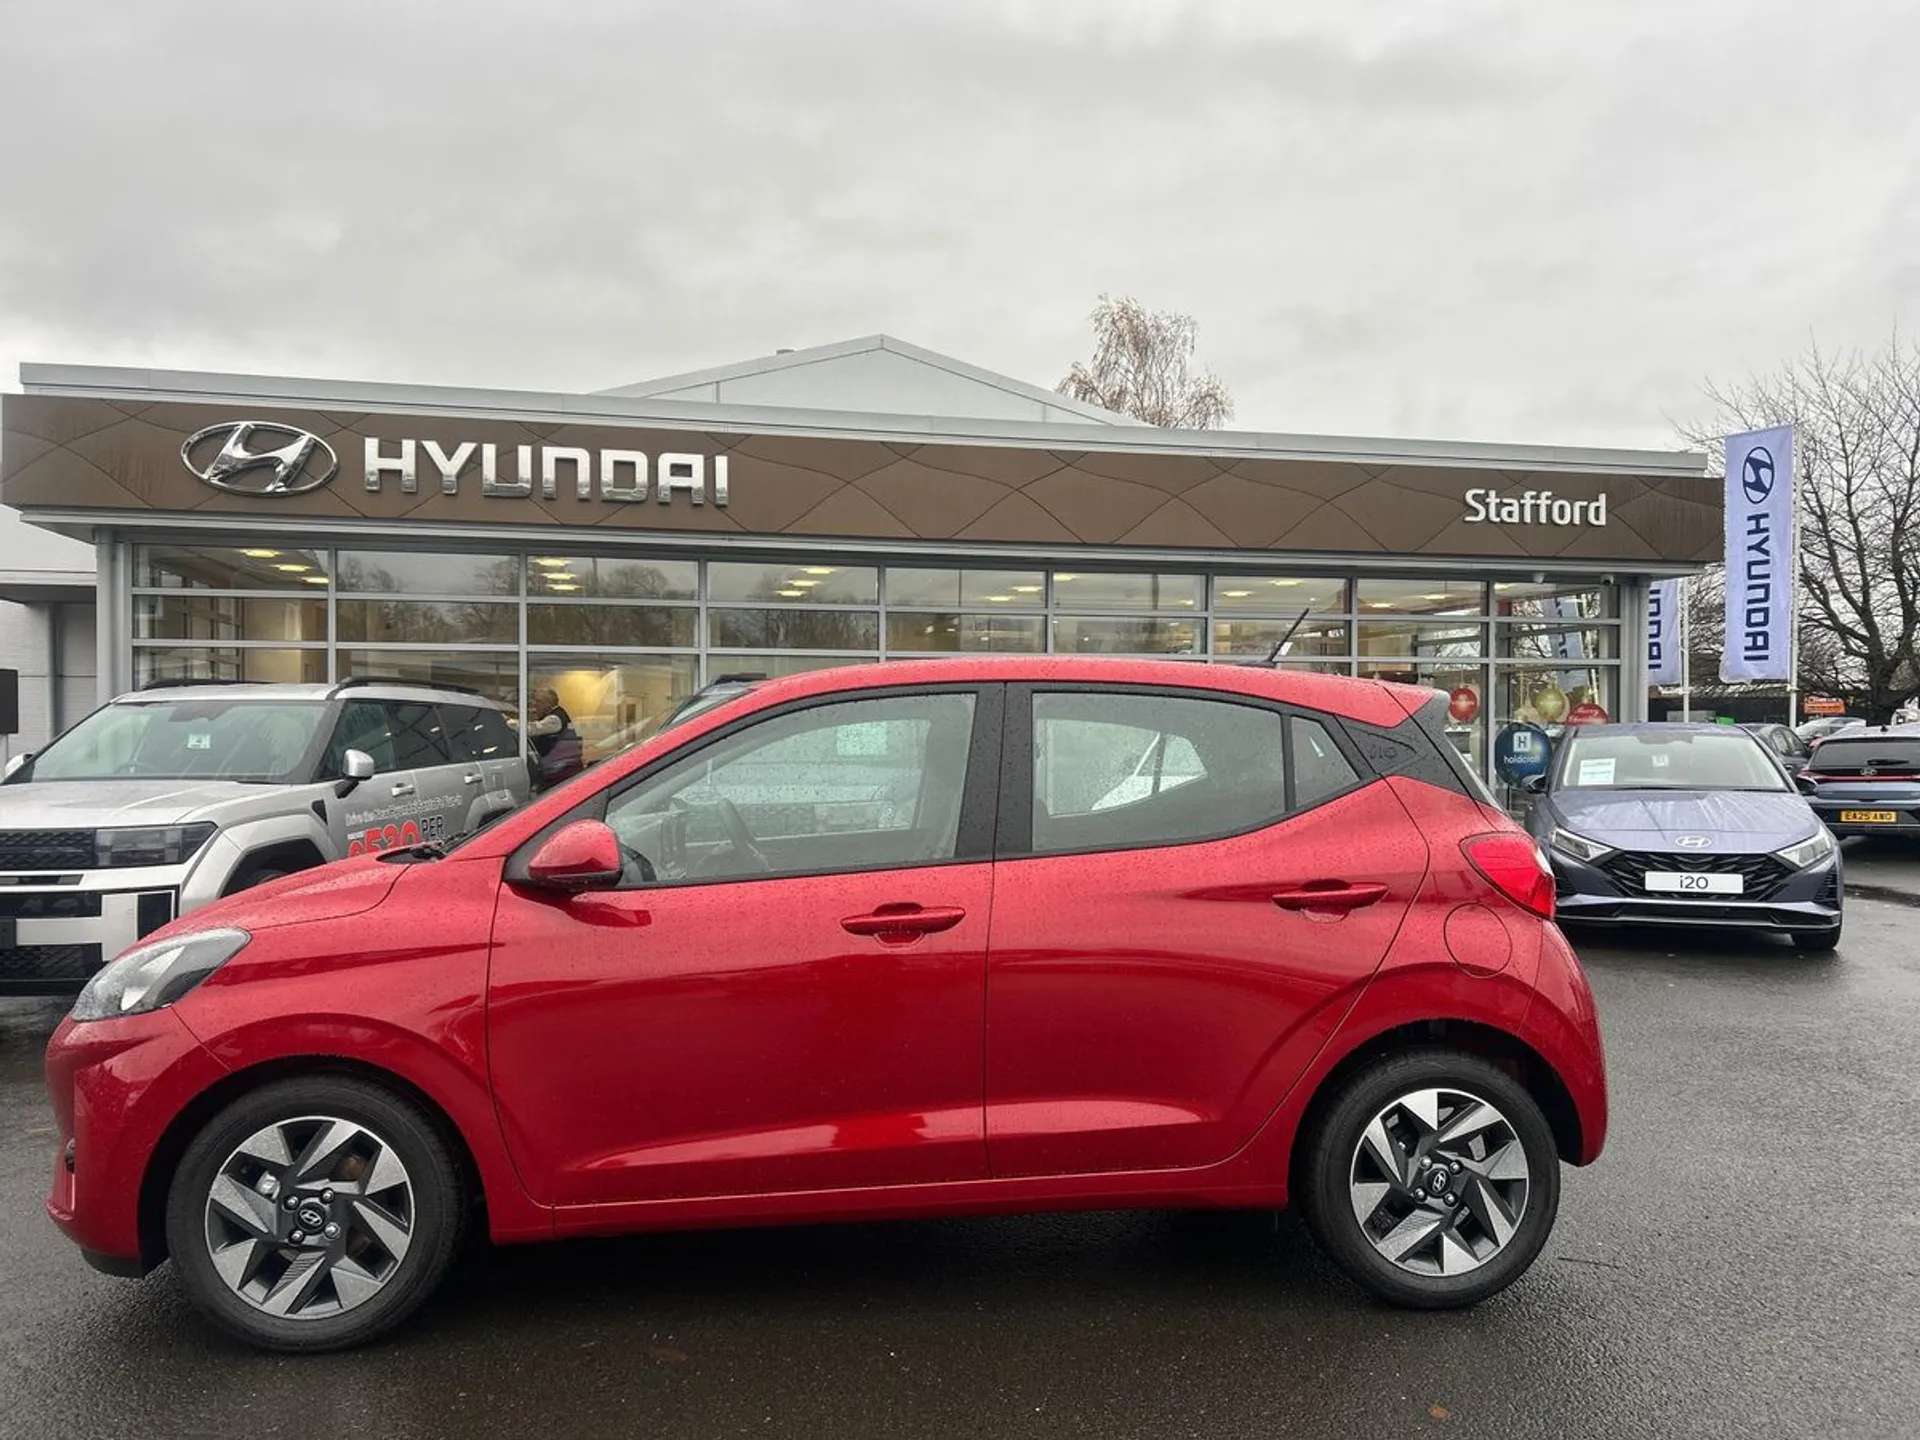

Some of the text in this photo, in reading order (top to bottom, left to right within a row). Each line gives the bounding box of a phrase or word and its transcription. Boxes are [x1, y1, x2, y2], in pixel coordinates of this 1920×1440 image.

[364, 437, 729, 507] HYUNDAI
[1464, 488, 1607, 526] Stafford
[1743, 513, 1771, 662] HYUNDAI
[420, 815, 446, 839] PER
[1680, 875, 1708, 889] i20
